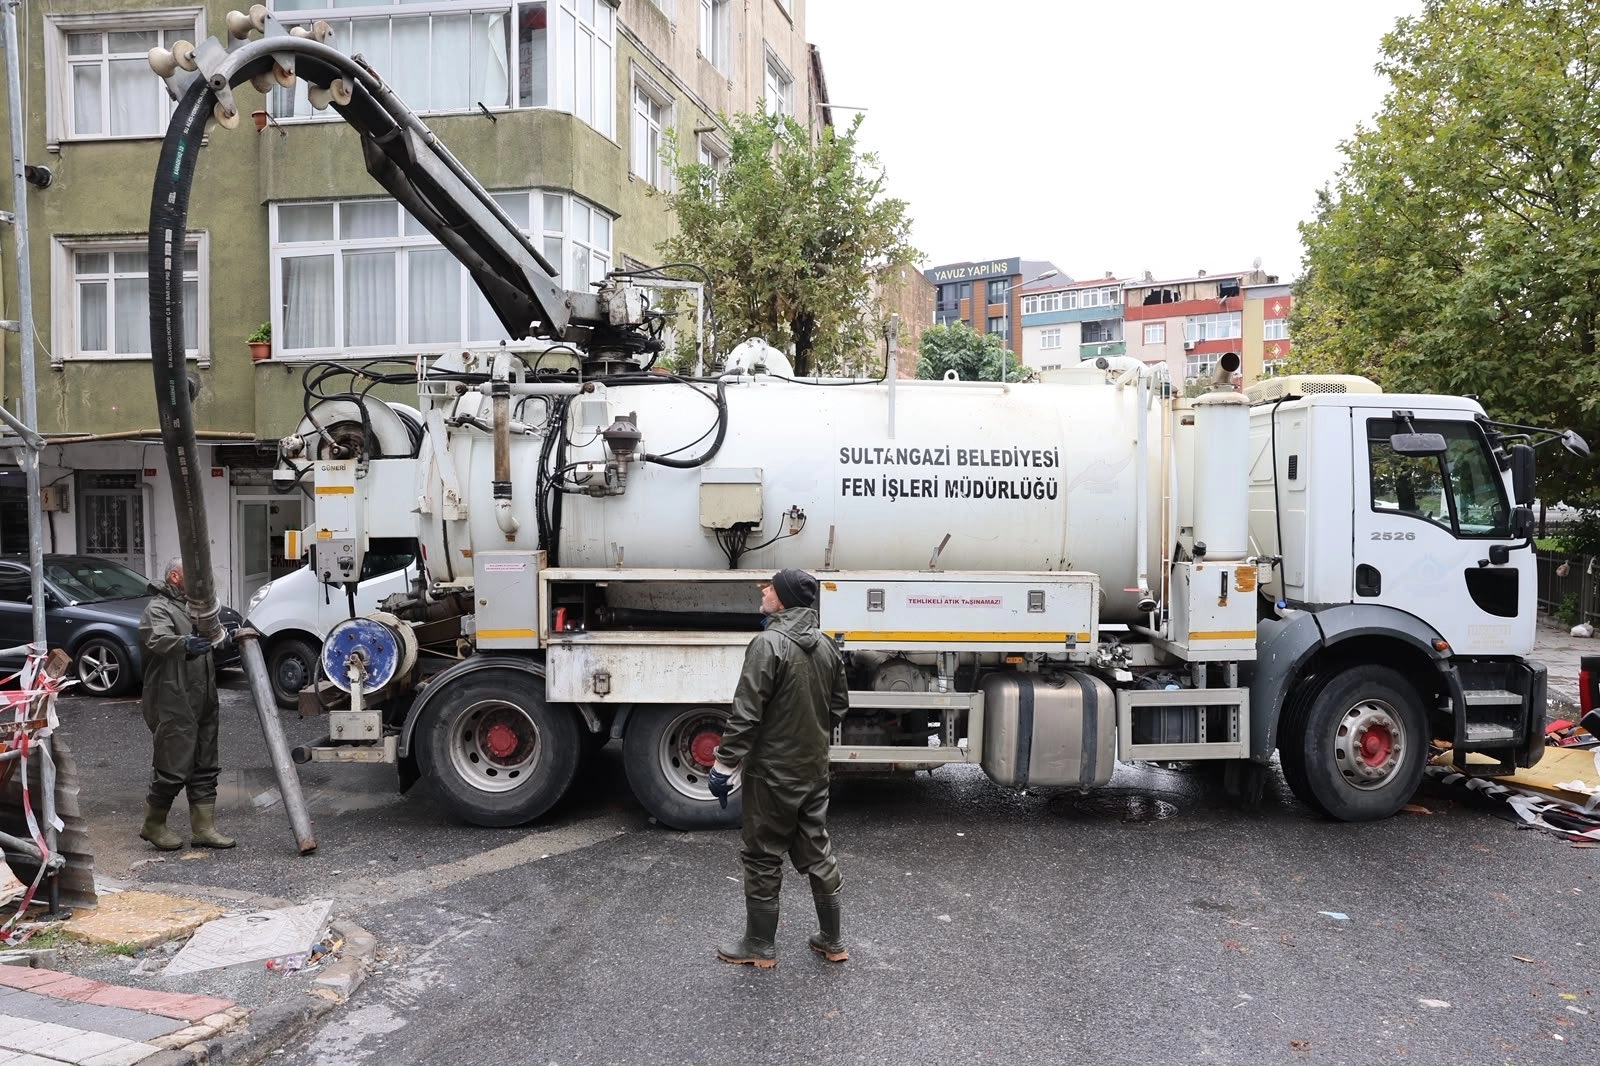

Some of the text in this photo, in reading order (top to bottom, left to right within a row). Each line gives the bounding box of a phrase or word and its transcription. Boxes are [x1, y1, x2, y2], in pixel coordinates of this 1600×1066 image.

[934, 261, 1008, 281] YAVUZ YAPI İNŞ
[839, 445, 1059, 468] SULTANGAZİ BELEDİYESİ
[321, 464, 346, 472] GÜNERİ
[841, 474, 1058, 502] FEN İŞLERİ MÜDÜRLÜĞÜ
[1370, 531, 1416, 541] 2526
[908, 597, 943, 605] TEHLİKELİ
